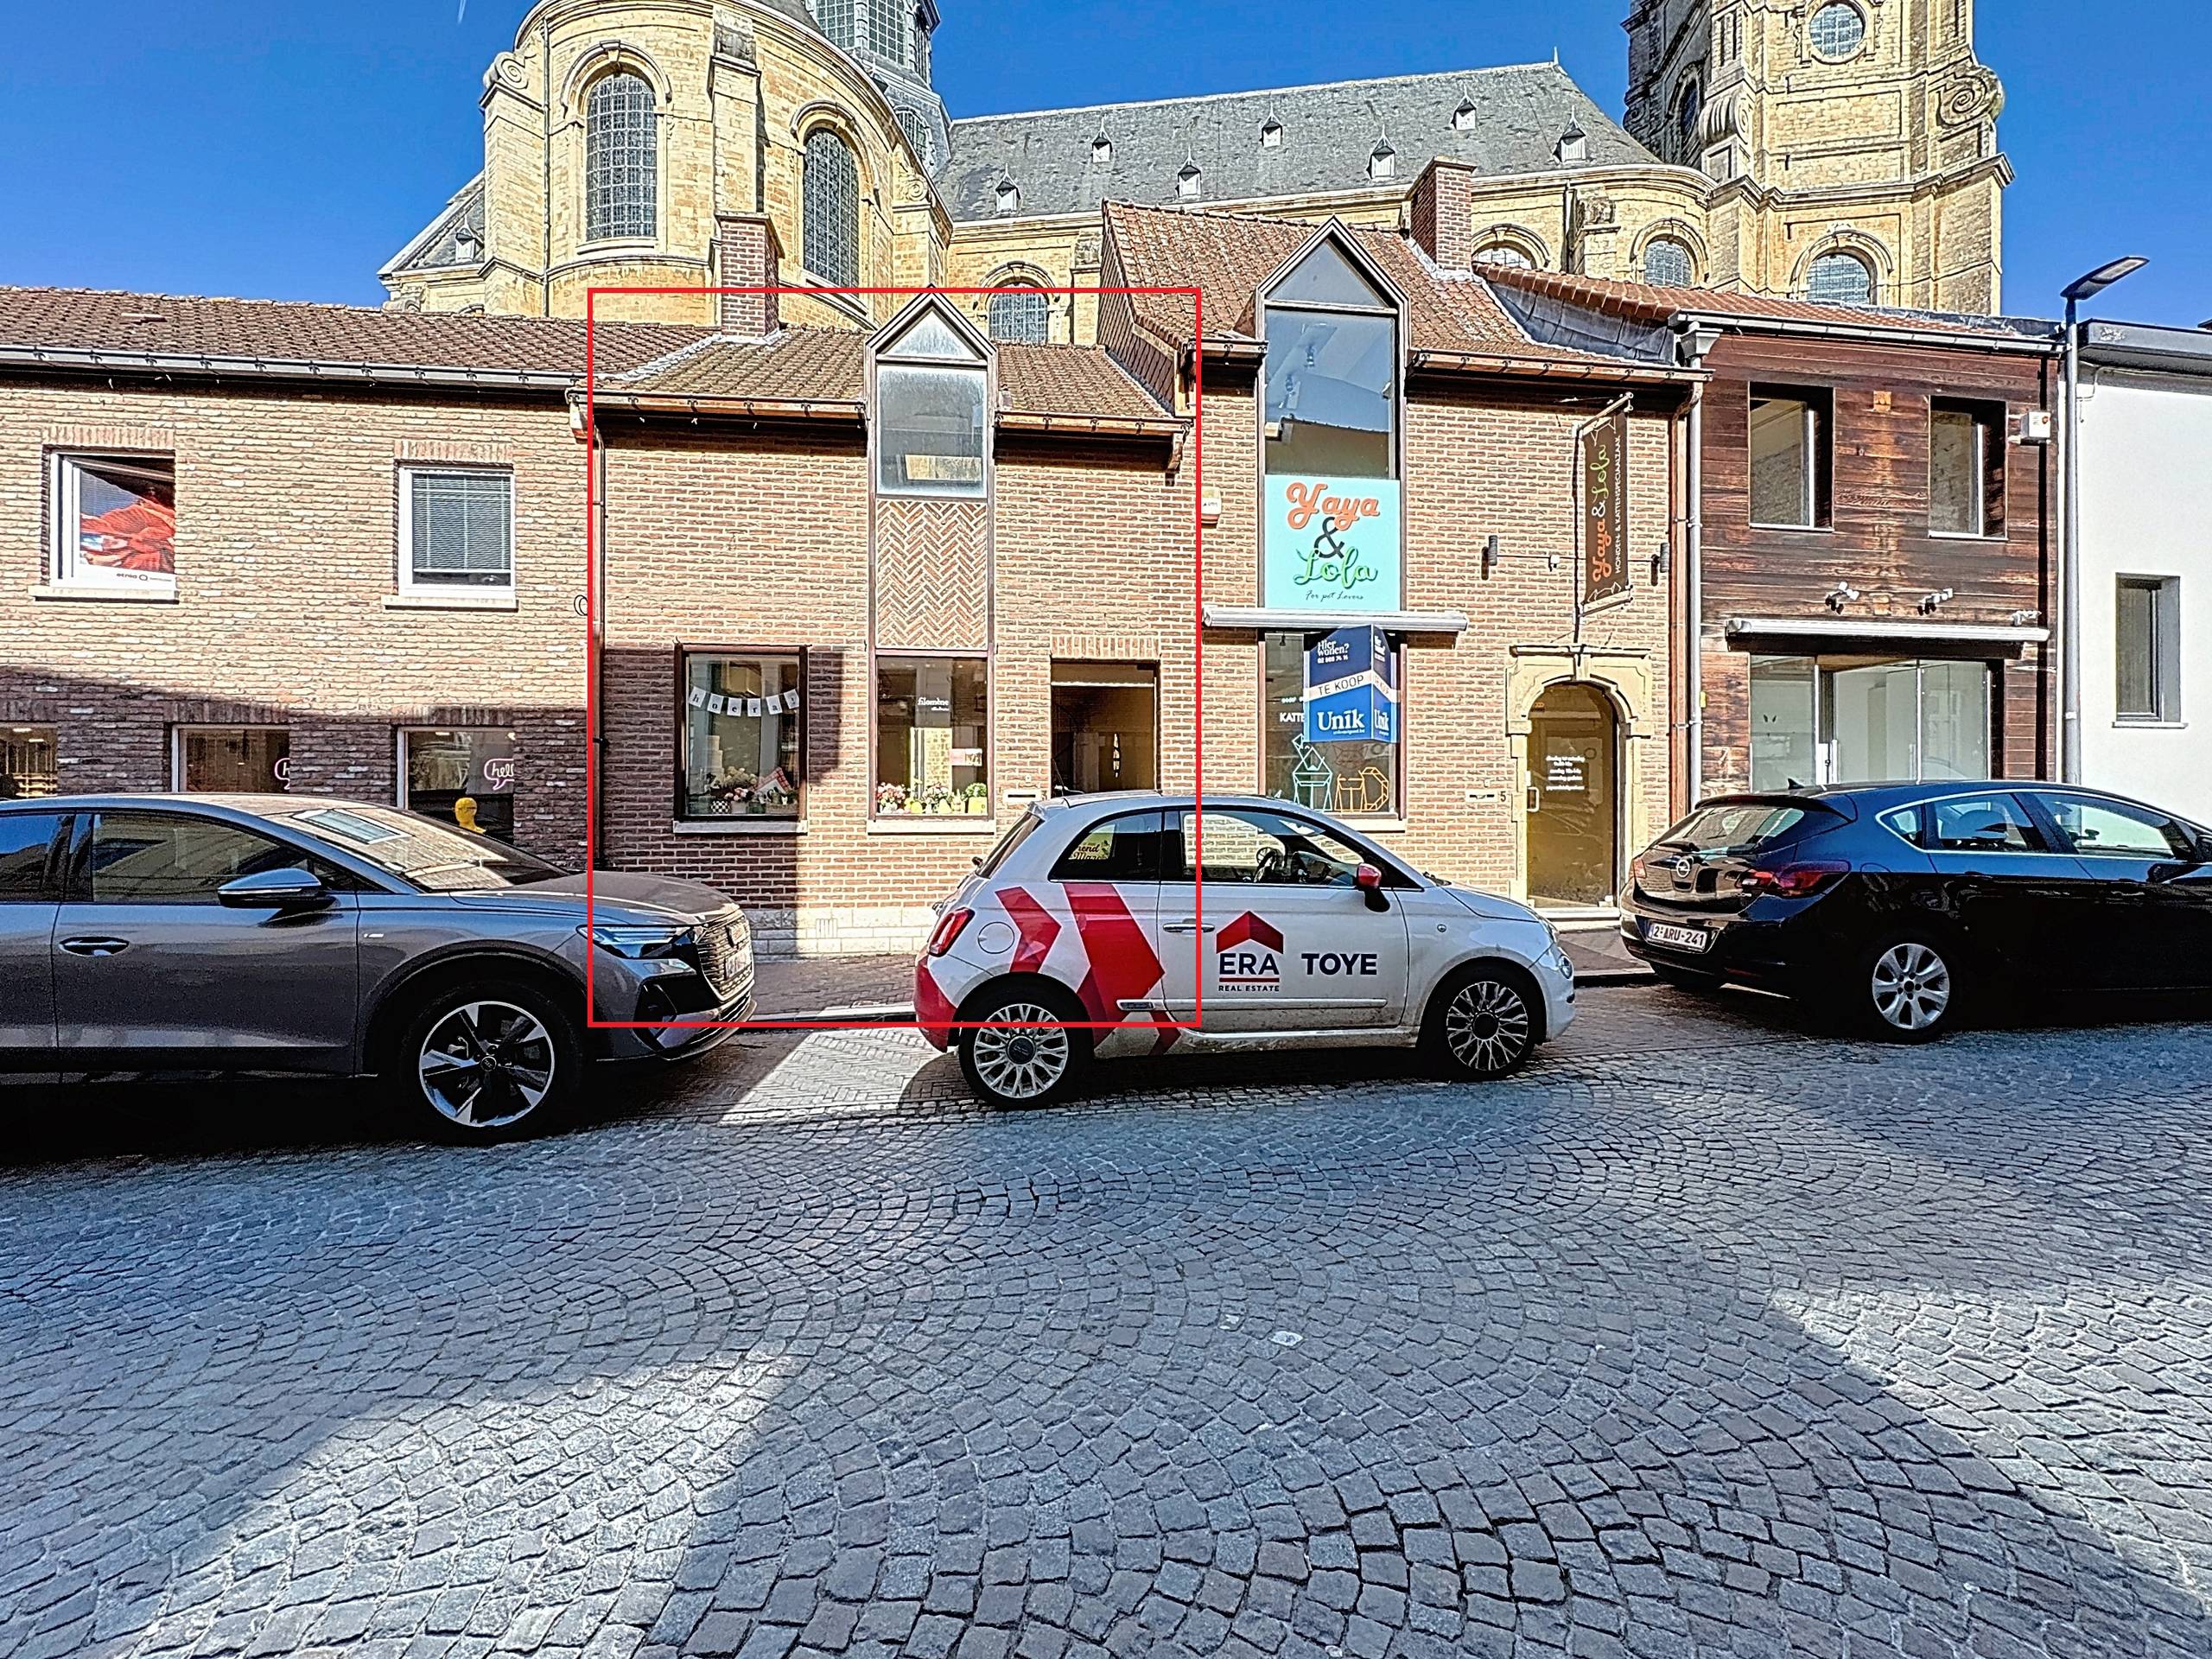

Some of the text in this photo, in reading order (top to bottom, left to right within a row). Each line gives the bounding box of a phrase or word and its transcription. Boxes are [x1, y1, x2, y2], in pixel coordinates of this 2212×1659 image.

[1286, 482, 1381, 531] Yaya
[1590, 444, 1612, 582] Yaya & Lola
[1313, 516, 1344, 559] &
[1293, 546, 1379, 589] Lola
[1318, 639, 1337, 650] Hier
[1318, 643, 1350, 657] wonen?
[1318, 686, 1330, 696] TE
[1334, 675, 1363, 691] KOOP
[1500, 791, 1506, 802] 5
[1219, 953, 1377, 976] ERA TOYE
